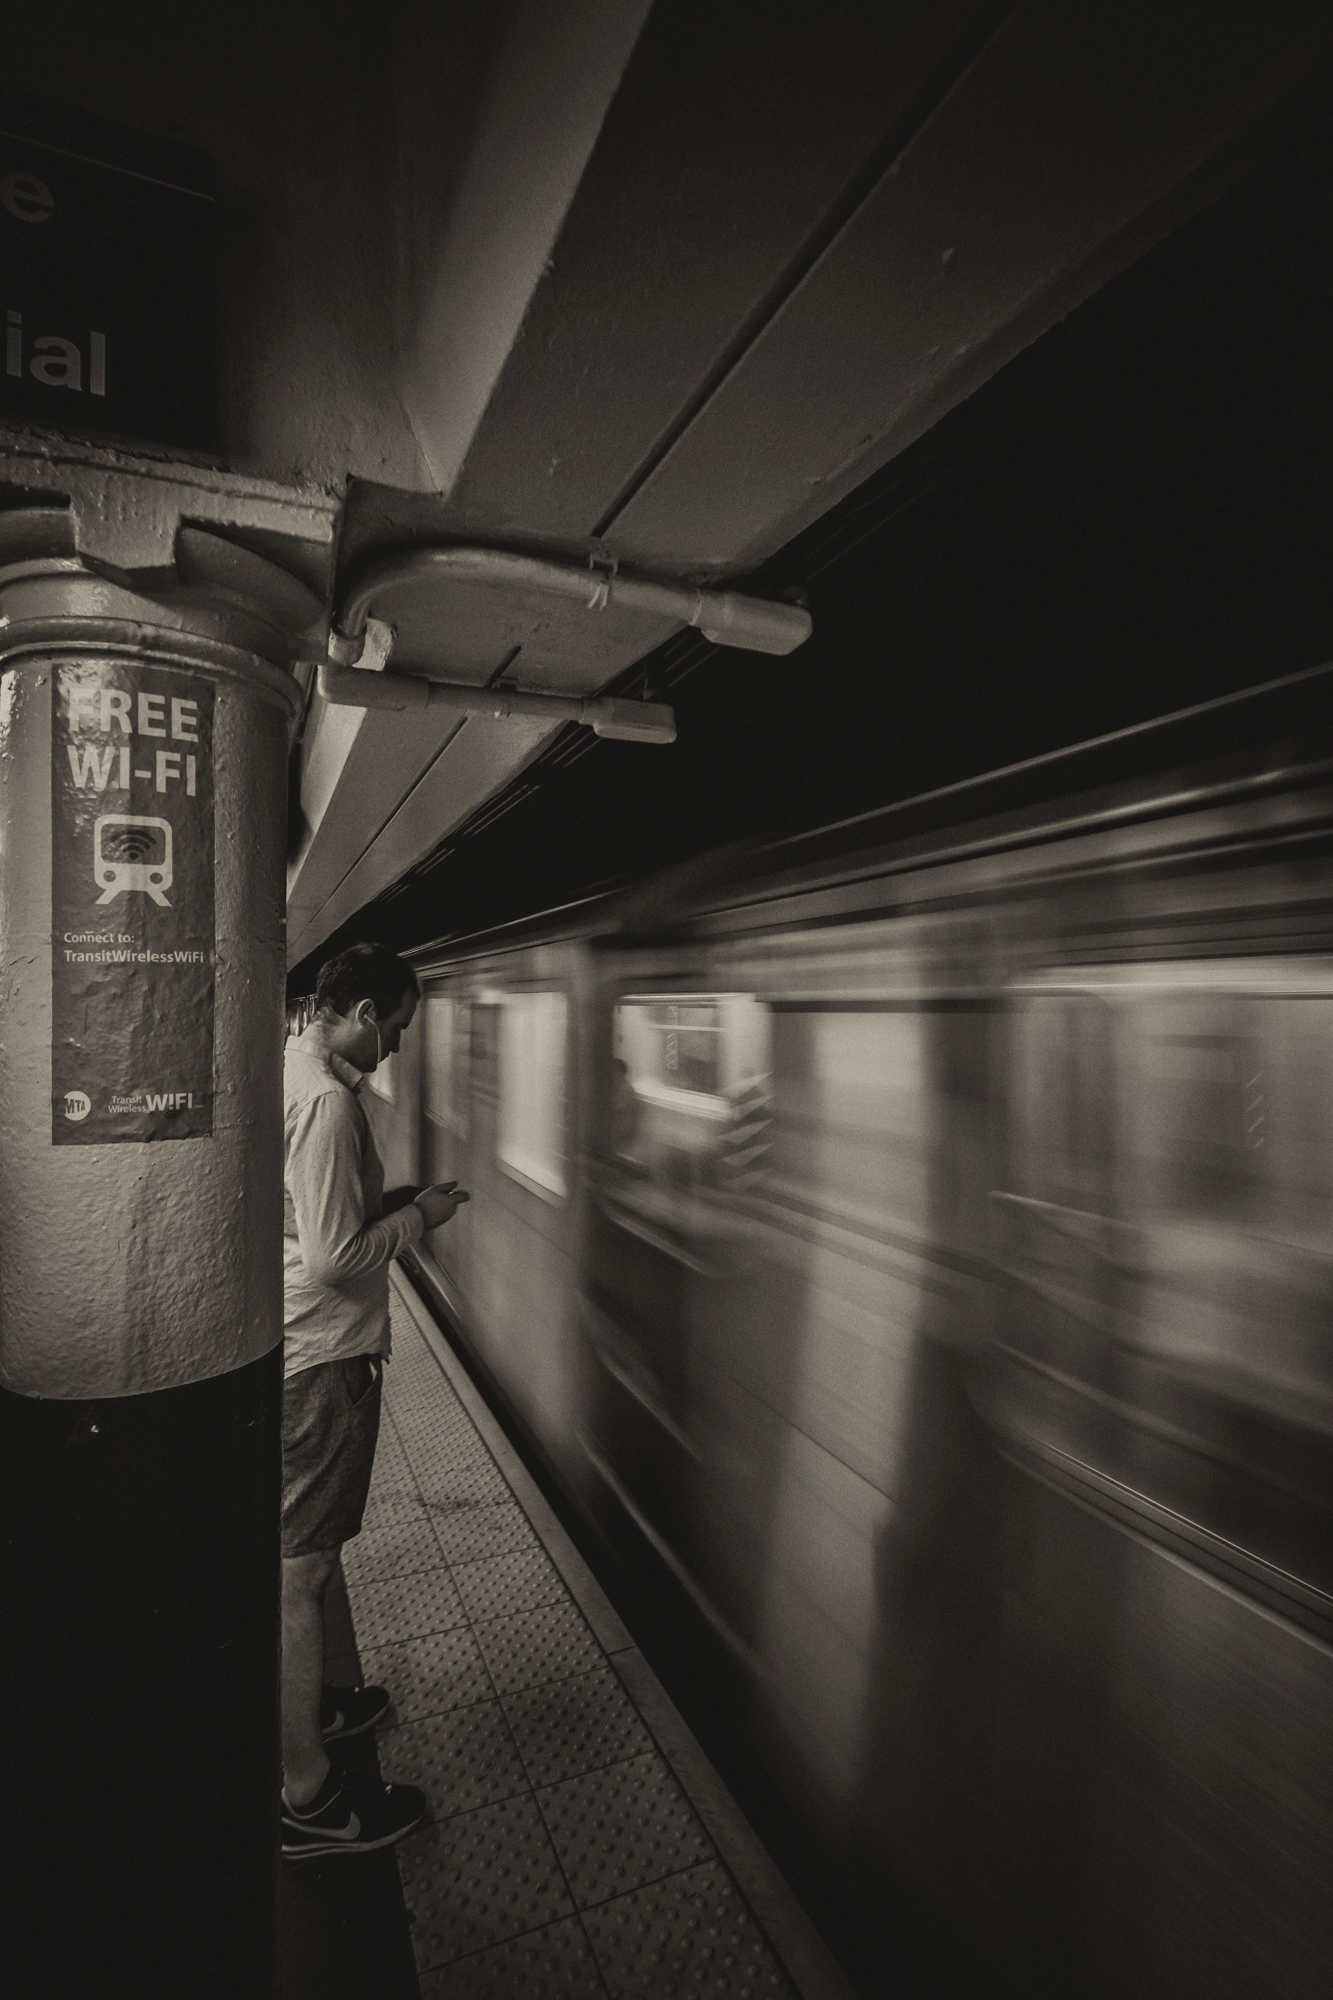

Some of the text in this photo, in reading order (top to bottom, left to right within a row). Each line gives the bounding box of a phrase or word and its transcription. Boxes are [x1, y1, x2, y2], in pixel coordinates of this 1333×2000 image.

[6, 309, 106, 397] ial
[68, 687, 199, 743] FREE
[66, 744, 197, 797] WI-FI
[63, 932, 135, 943] Connect to:
[63, 950, 204, 963] TransitWirelessWiFi
[111, 1095, 142, 1104] Transit
[107, 1104, 146, 1113] Wireless
